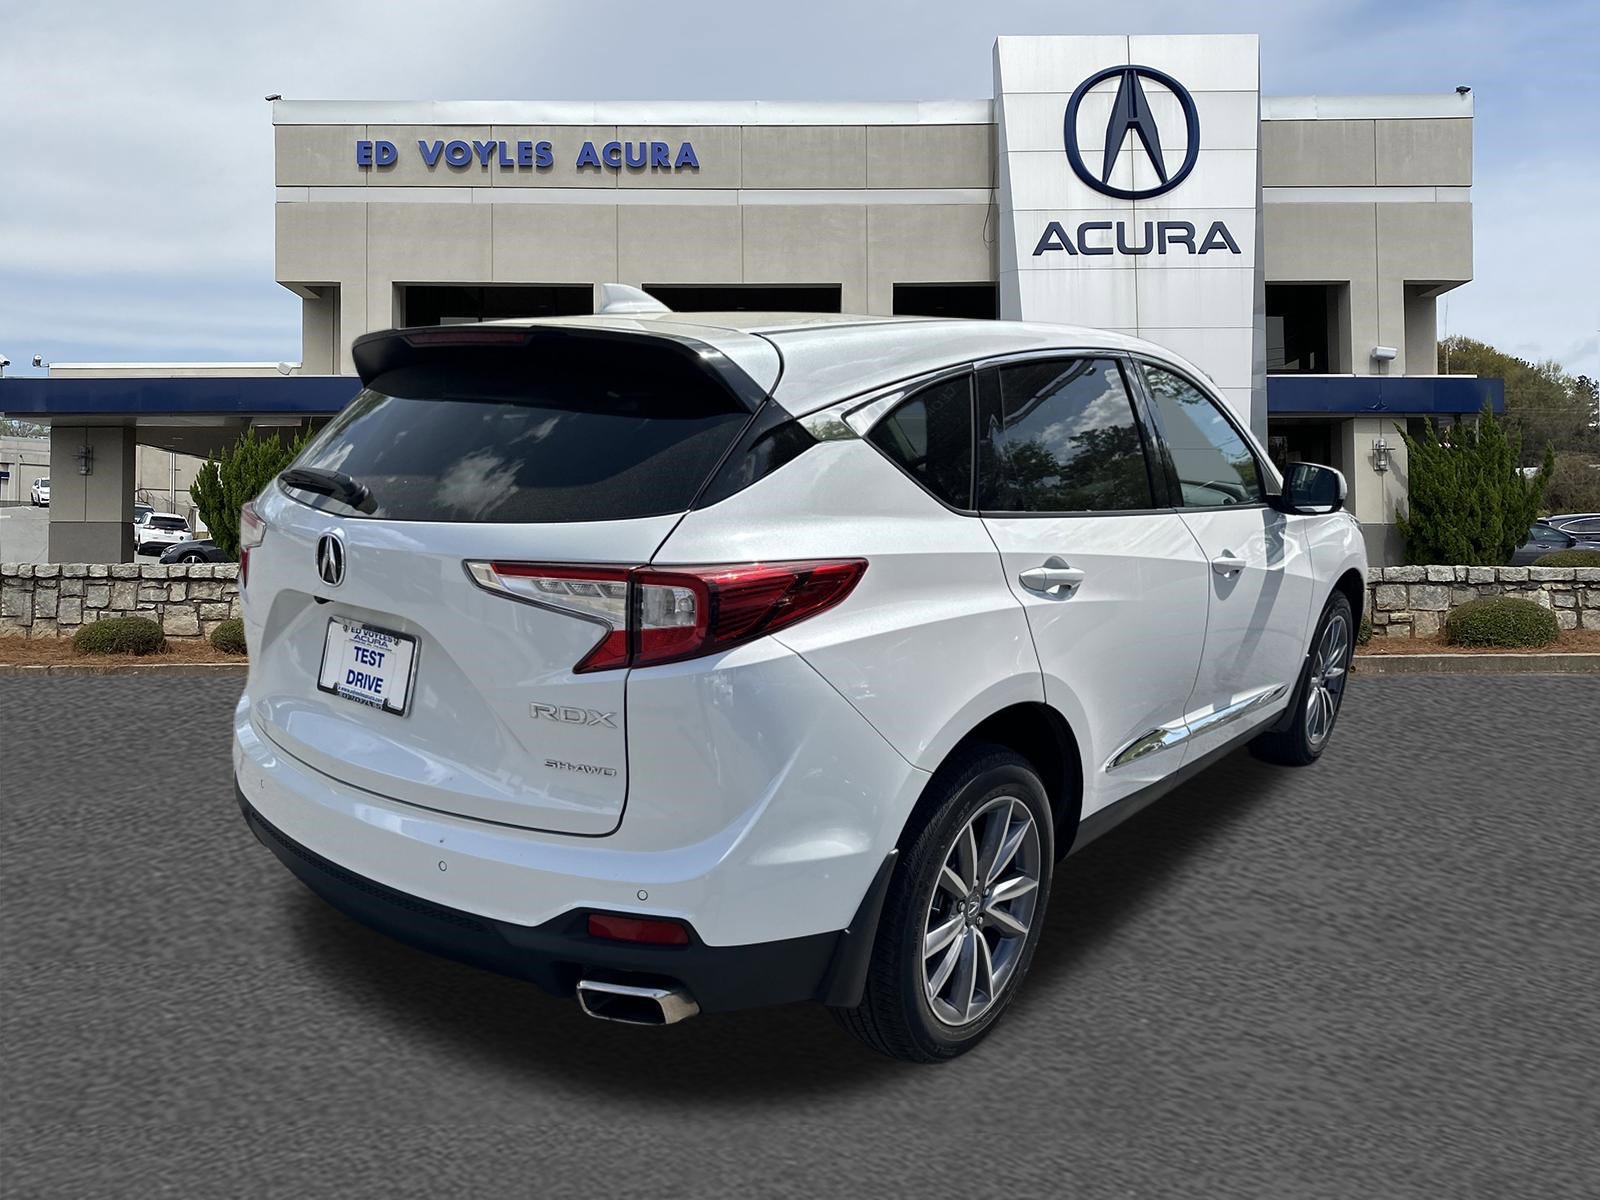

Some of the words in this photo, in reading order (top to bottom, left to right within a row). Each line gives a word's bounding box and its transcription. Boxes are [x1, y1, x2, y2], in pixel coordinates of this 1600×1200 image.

[355, 140, 399, 167] ED
[417, 140, 554, 169] VOYLES
[576, 140, 700, 169] ACURA
[1032, 220, 1242, 256] ACURA
[353, 634, 388, 648] ACURA
[354, 646, 385, 668] TEST
[345, 669, 384, 694] DRIVE
[529, 701, 618, 729] RDX
